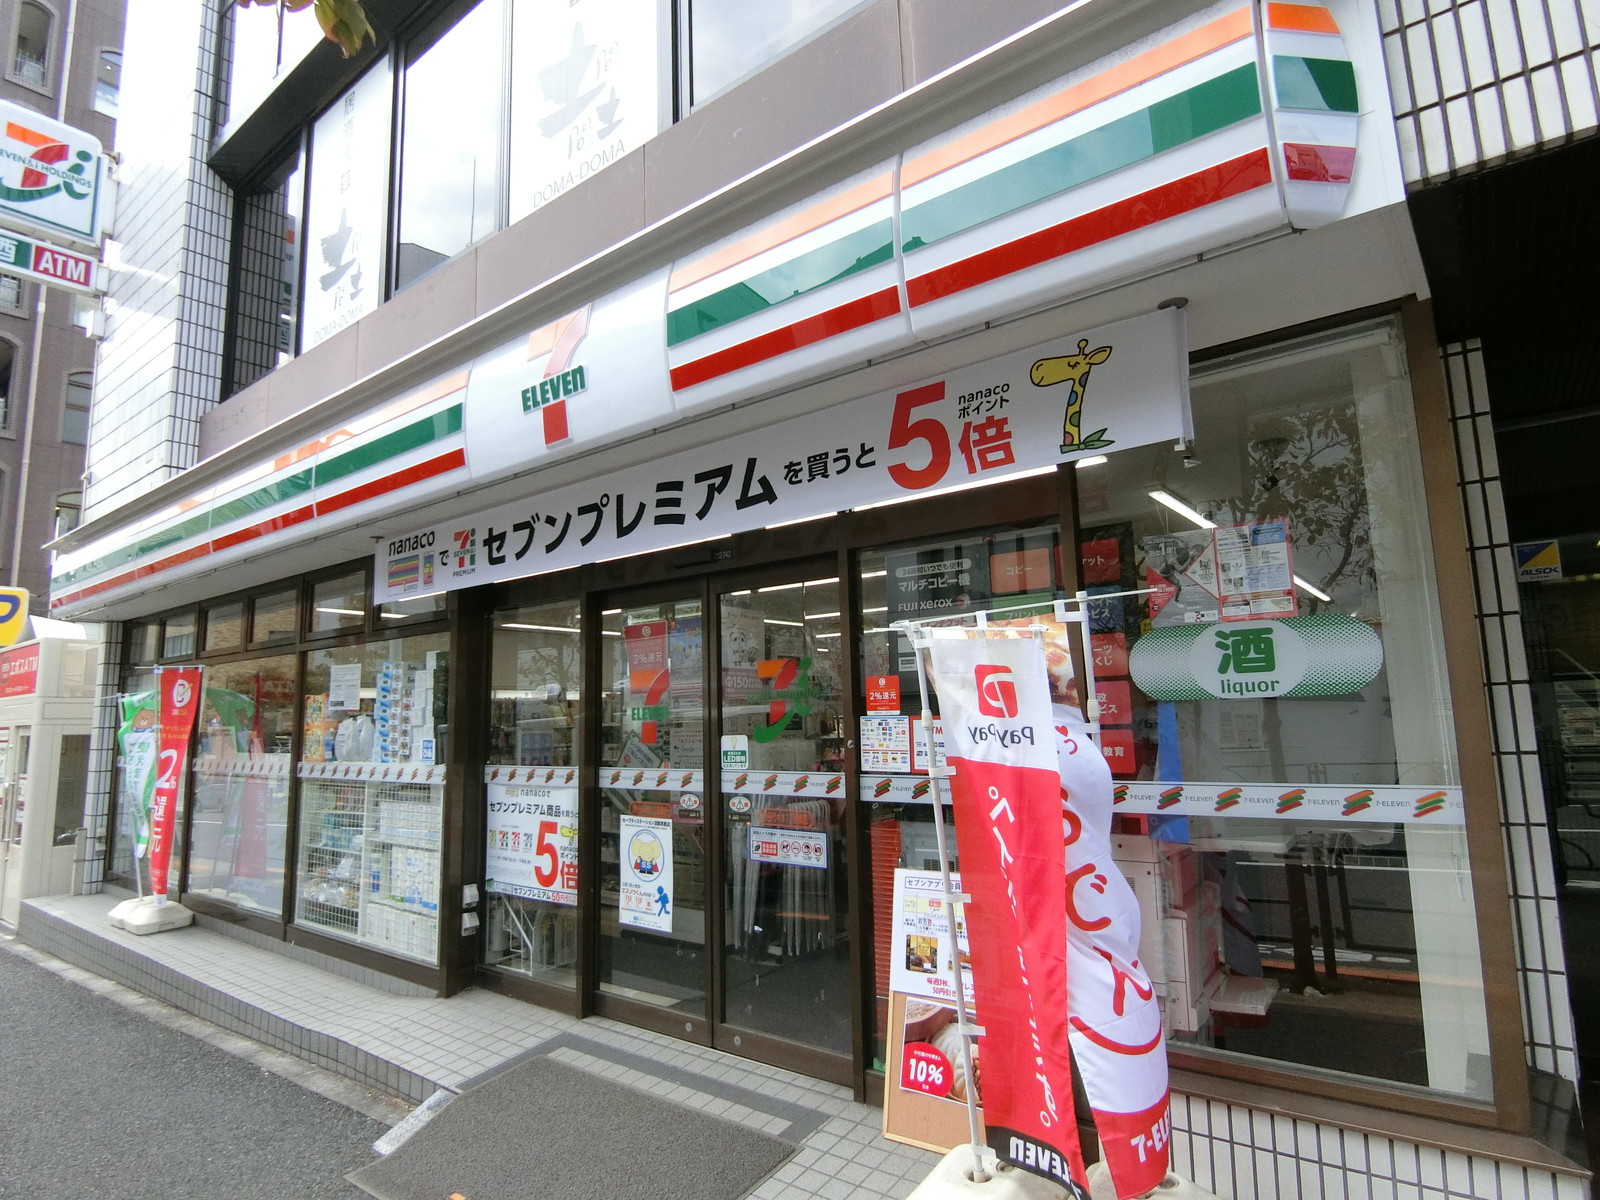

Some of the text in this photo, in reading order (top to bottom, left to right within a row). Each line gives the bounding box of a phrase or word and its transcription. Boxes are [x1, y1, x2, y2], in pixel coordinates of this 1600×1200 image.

[41, 163, 92, 189] HOLDINGS
[533, 139, 625, 208] DOMA-DOMA
[38, 251, 86, 283] ATM
[958, 381, 1010, 405] nanaco
[958, 395, 1011, 419] ポイント
[887, 380, 952, 490] 5
[957, 414, 1017, 475] 倍
[439, 442, 876, 566] で セブンプレミアム を買うと
[389, 531, 435, 556] nanaco
[453, 568, 476, 577] PREMIUM
[902, 562, 964, 576] 24時間いつでも便利
[1006, 566, 1033, 576] コピー
[1521, 567, 1559, 576] ALSOK
[898, 573, 971, 592] マルチコピー機
[898, 598, 952, 611] FUJI xerox
[1214, 627, 1276, 675] 酒
[869, 691, 897, 700] 2%還元
[1220, 678, 1280, 696] liquor
[1103, 746, 1125, 757] 教育
[534, 820, 559, 888] 5
[560, 861, 578, 890] 倍
[909, 1058, 944, 1085] 10%
